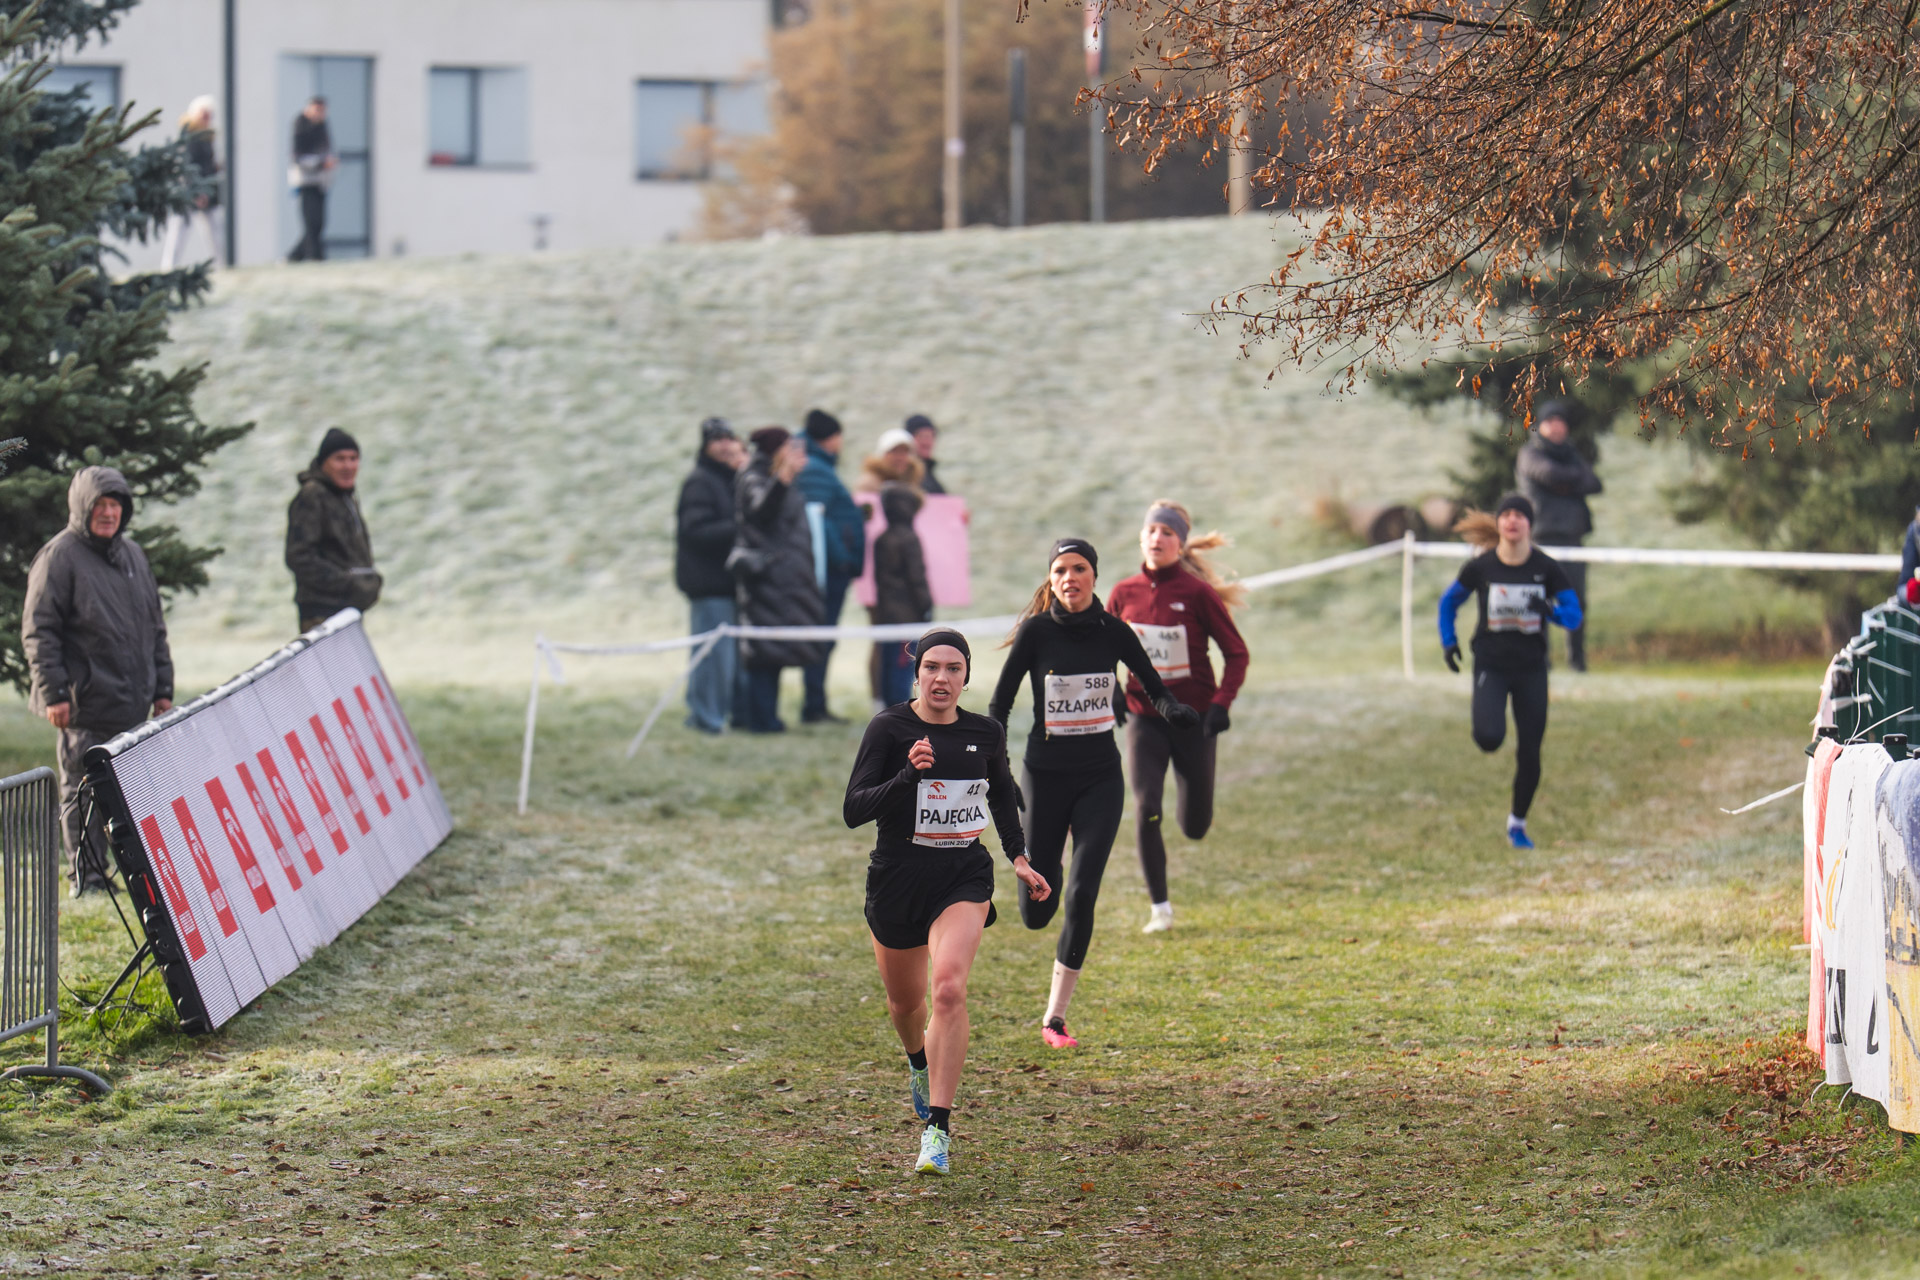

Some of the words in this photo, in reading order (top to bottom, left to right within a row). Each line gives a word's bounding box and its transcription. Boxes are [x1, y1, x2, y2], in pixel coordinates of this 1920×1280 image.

[1085, 677, 1109, 689] 588
[1047, 696, 1109, 713] SZŁAPKA
[966, 783, 981, 796] 41
[920, 805, 985, 828] PAJĘCKA
